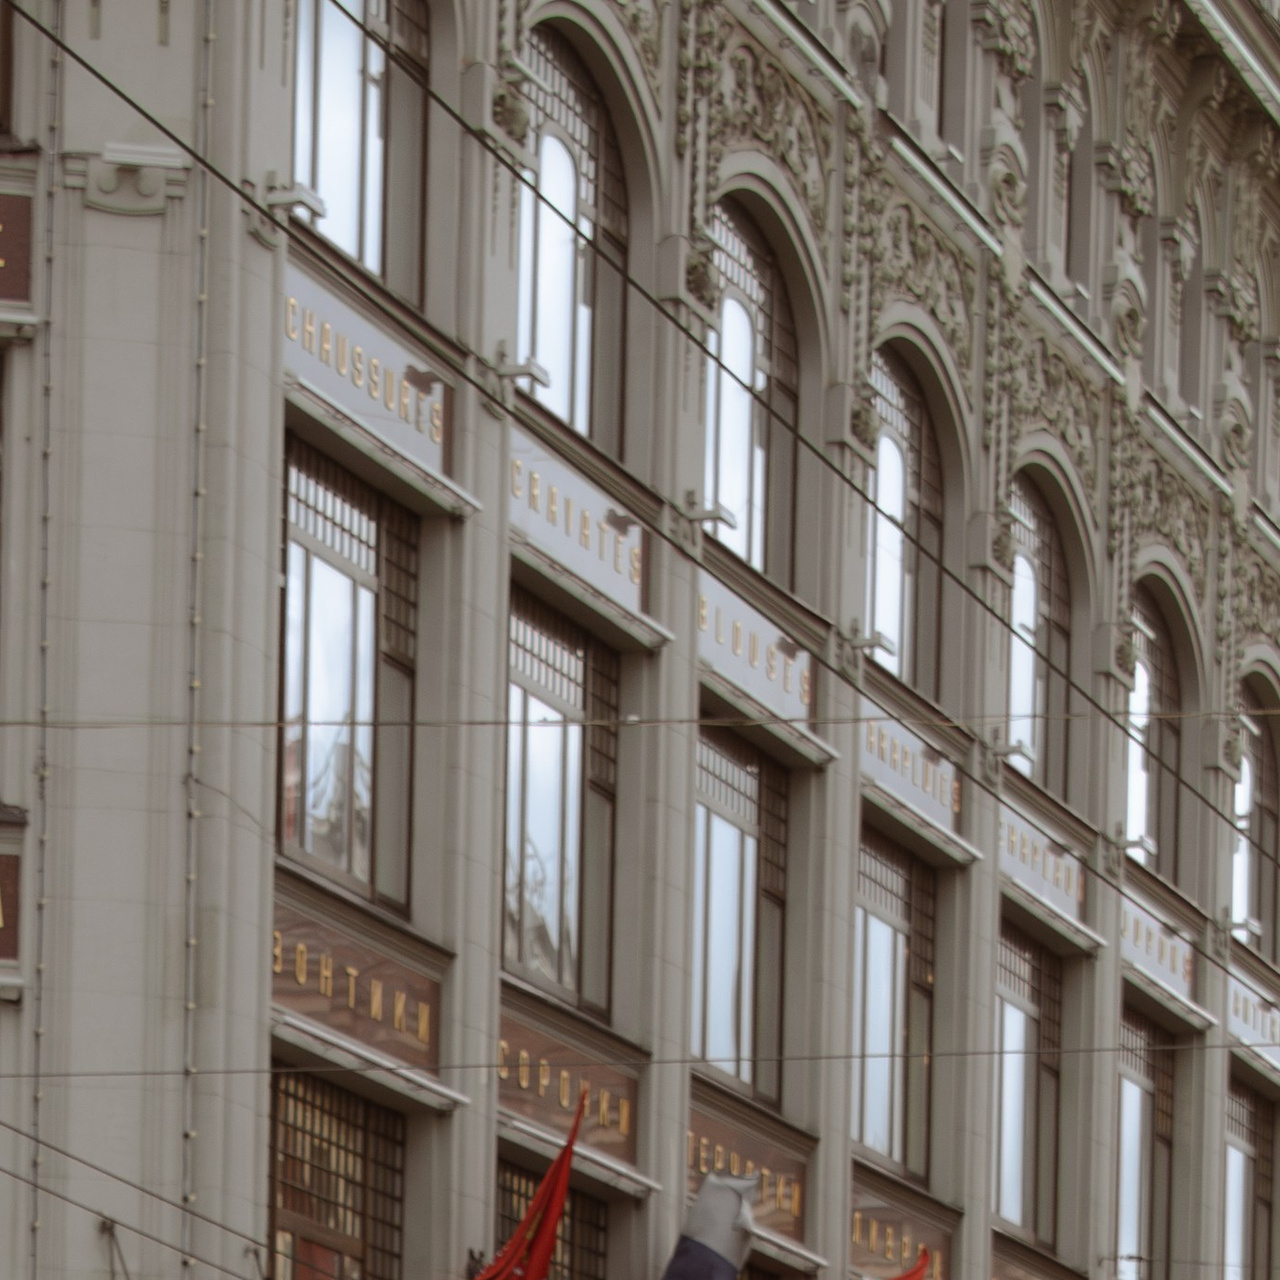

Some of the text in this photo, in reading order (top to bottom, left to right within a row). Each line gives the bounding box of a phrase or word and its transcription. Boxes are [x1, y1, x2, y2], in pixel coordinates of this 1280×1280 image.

[285, 297, 443, 444] CHAUSSURES
[511, 459, 642, 586] CRAVATES
[698, 594, 811, 706] BLOUSES
[866, 719, 961, 813] ARAPLUIES
[272, 930, 431, 1044] ЗОНТИКИ
